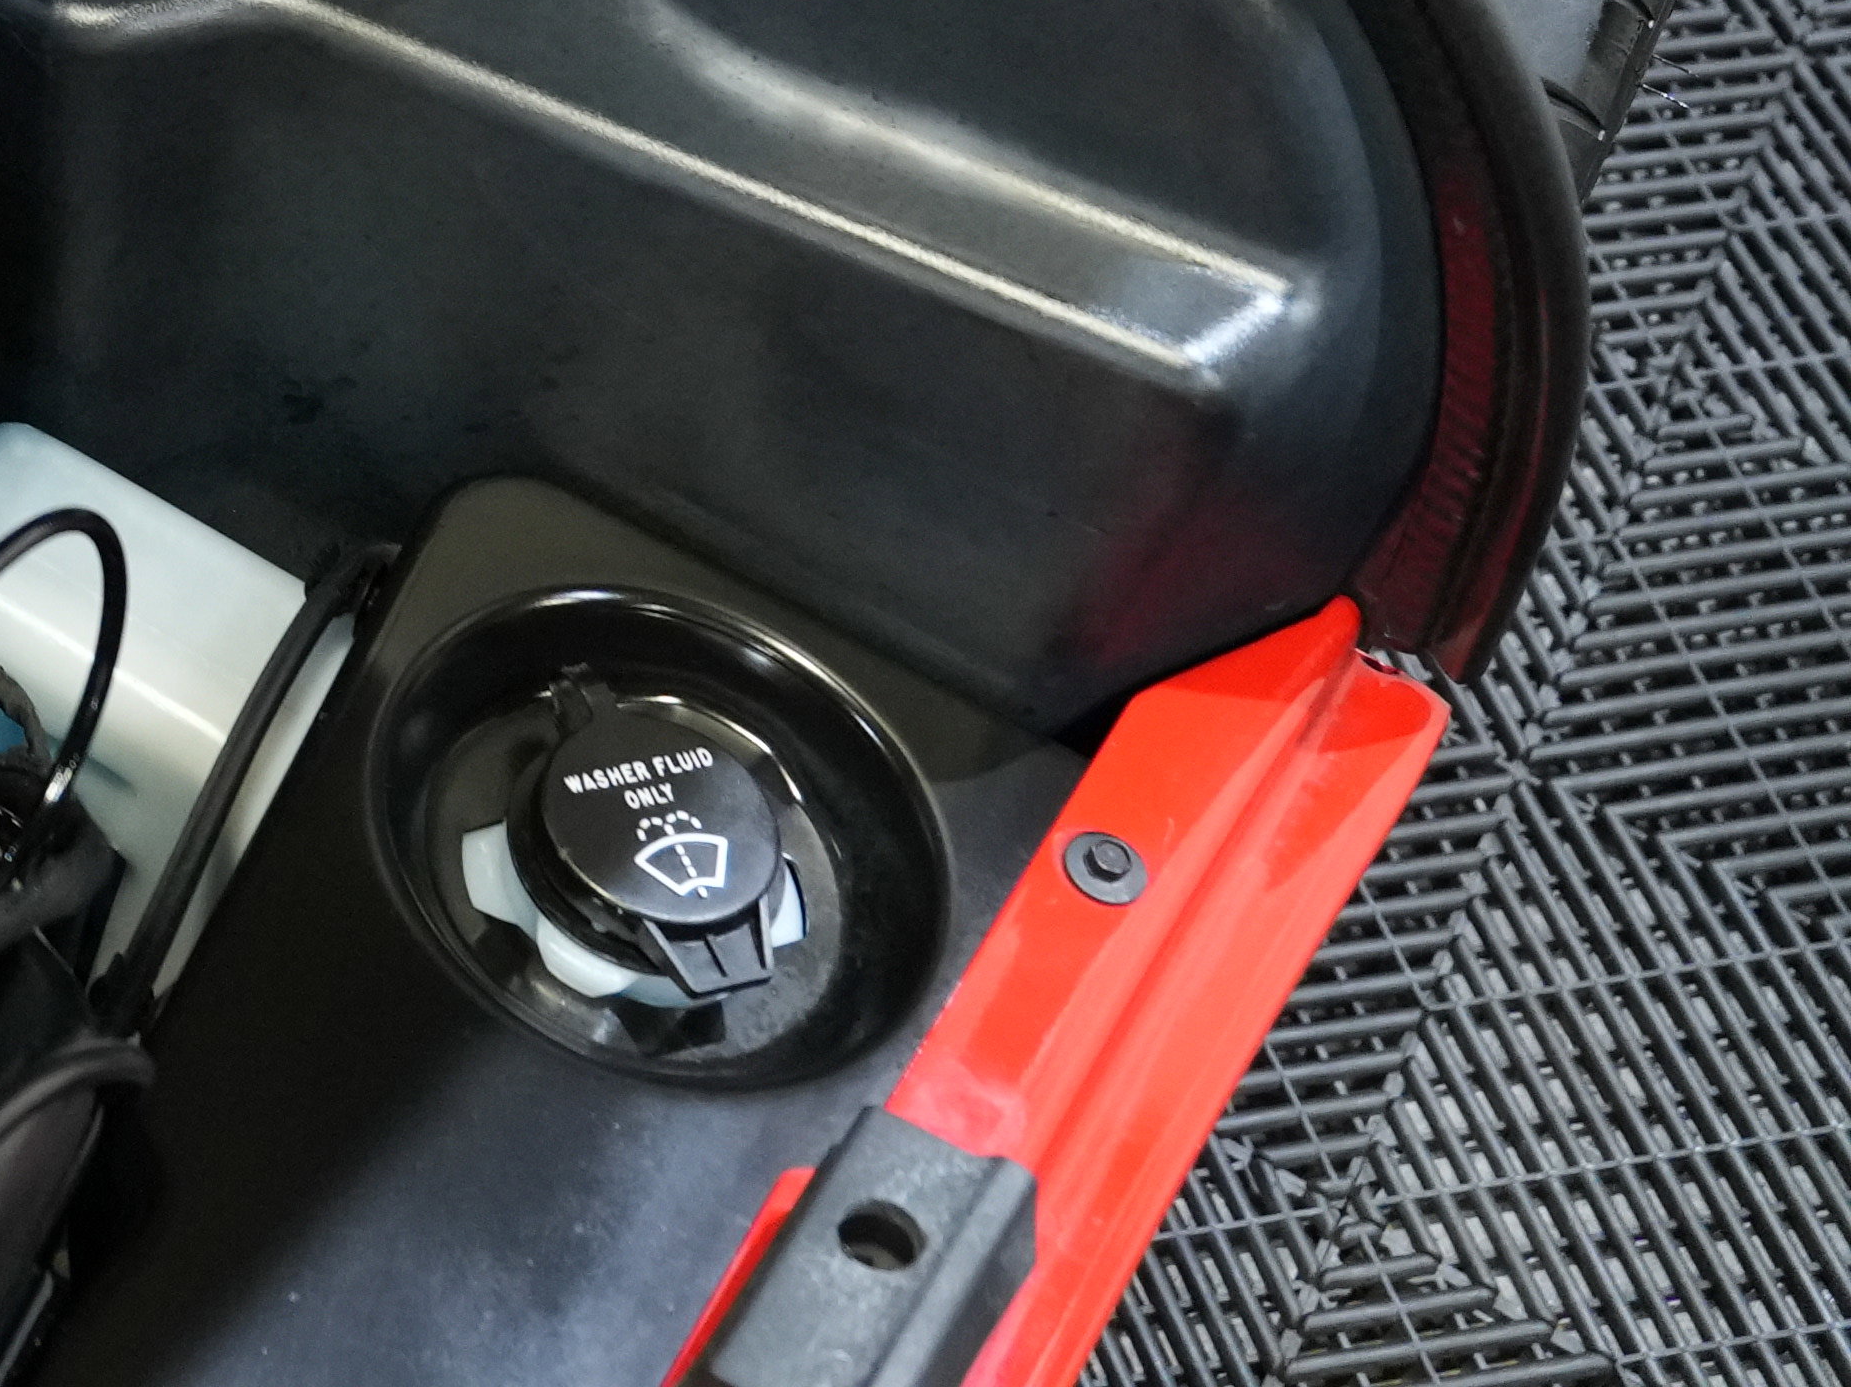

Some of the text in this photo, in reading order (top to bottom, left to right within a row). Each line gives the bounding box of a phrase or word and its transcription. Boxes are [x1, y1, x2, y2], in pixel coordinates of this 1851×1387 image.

[564, 747, 714, 794] WASHER FLUID
[624, 783, 675, 809] ONLY
